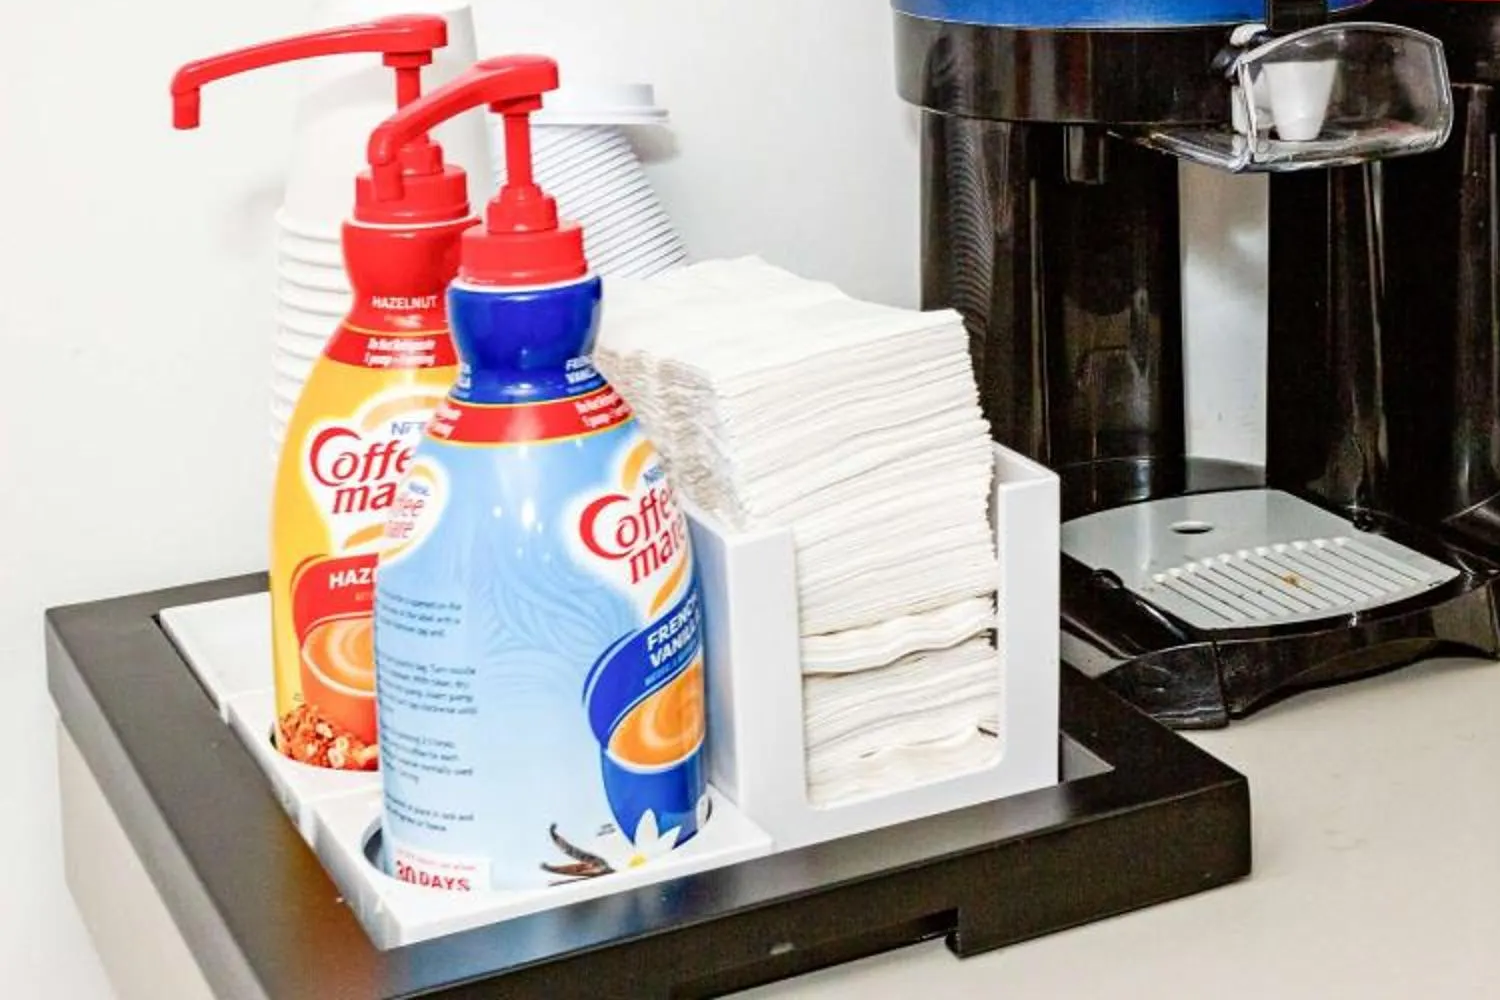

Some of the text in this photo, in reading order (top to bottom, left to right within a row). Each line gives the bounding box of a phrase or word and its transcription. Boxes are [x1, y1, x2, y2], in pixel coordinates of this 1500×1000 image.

[371, 295, 437, 311] HAZELNUT
[310, 426, 413, 487] Coffe
[332, 481, 398, 515] ma
[419, 871, 471, 892] DAYS
